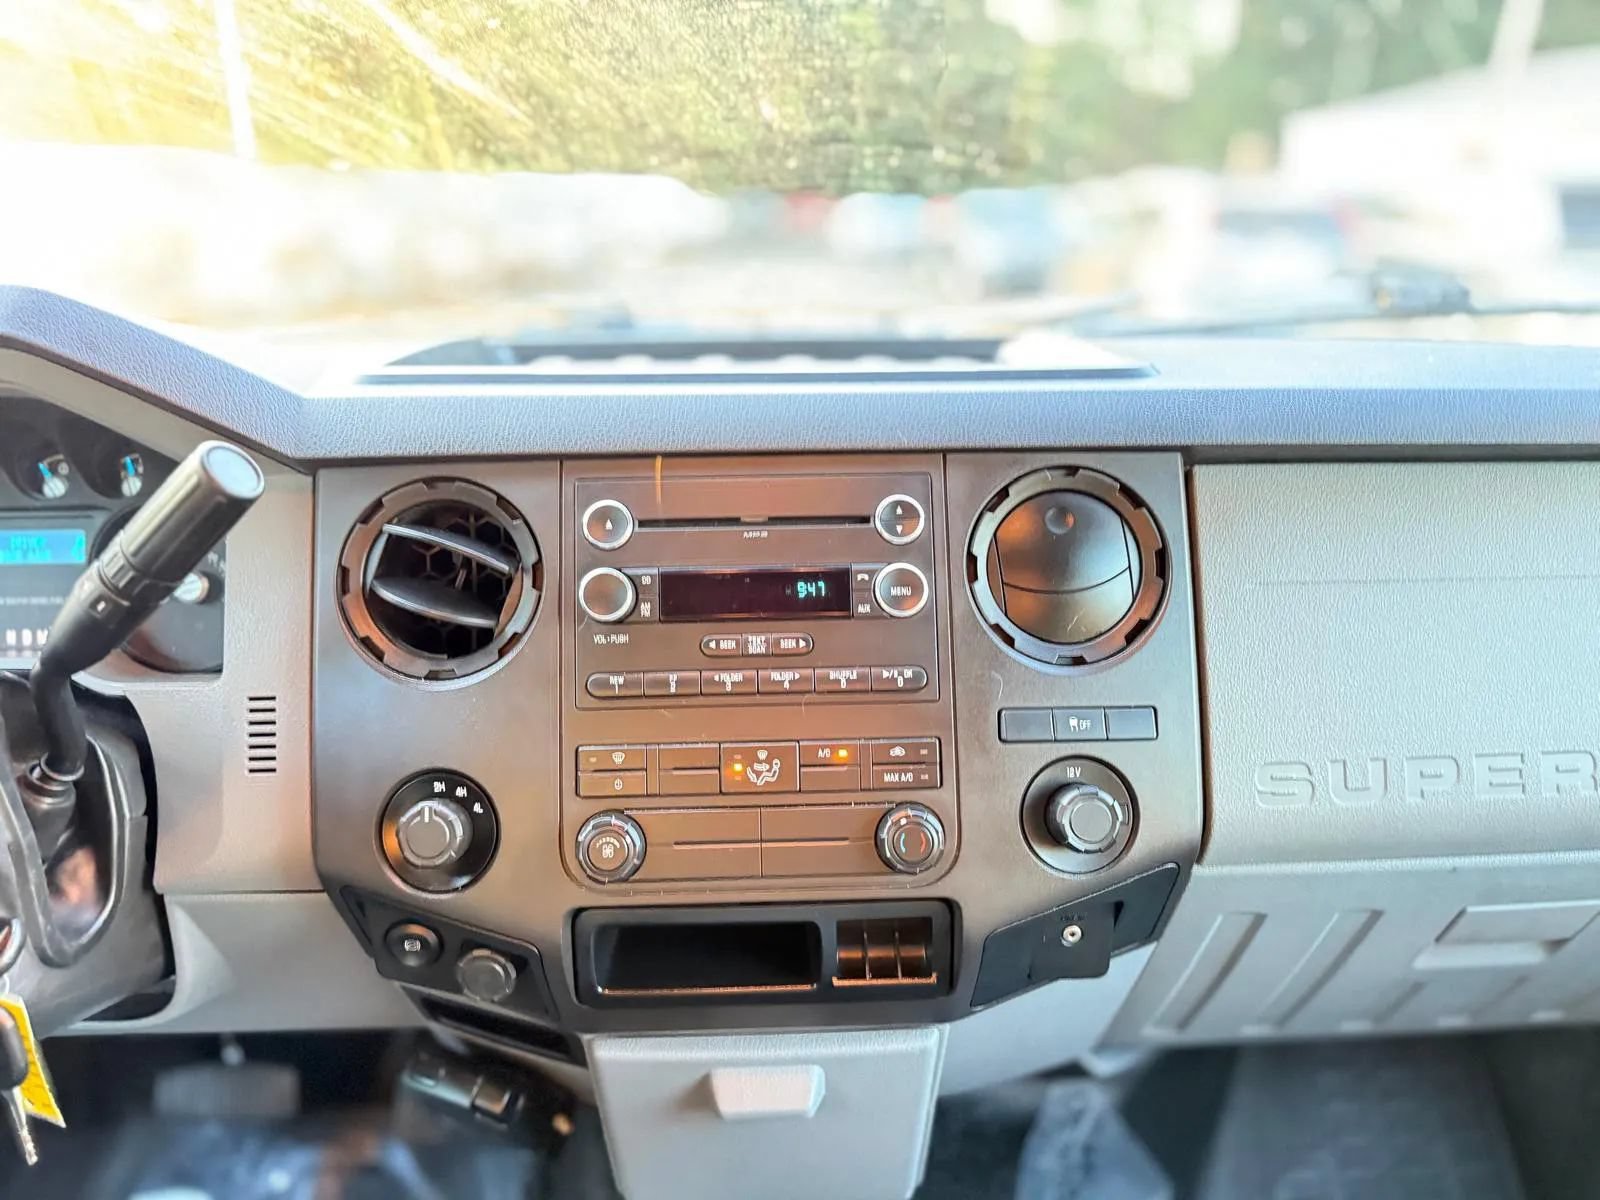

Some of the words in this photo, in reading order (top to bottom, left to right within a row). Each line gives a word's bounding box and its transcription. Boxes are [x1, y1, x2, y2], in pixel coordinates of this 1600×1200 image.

[890, 586, 912, 597] MENU
[857, 603, 871, 614] AUX
[719, 672, 743, 683] FOLDER
[770, 671, 794, 681] FOLDER
[1079, 719, 1091, 731] OFF
[817, 747, 831, 759] A/C
[883, 772, 899, 783] MAX
[900, 772, 914, 783] A/C
[1255, 751, 1600, 808] SUPER
[455, 785, 468, 798] 4H
[473, 801, 484, 814] 4L
